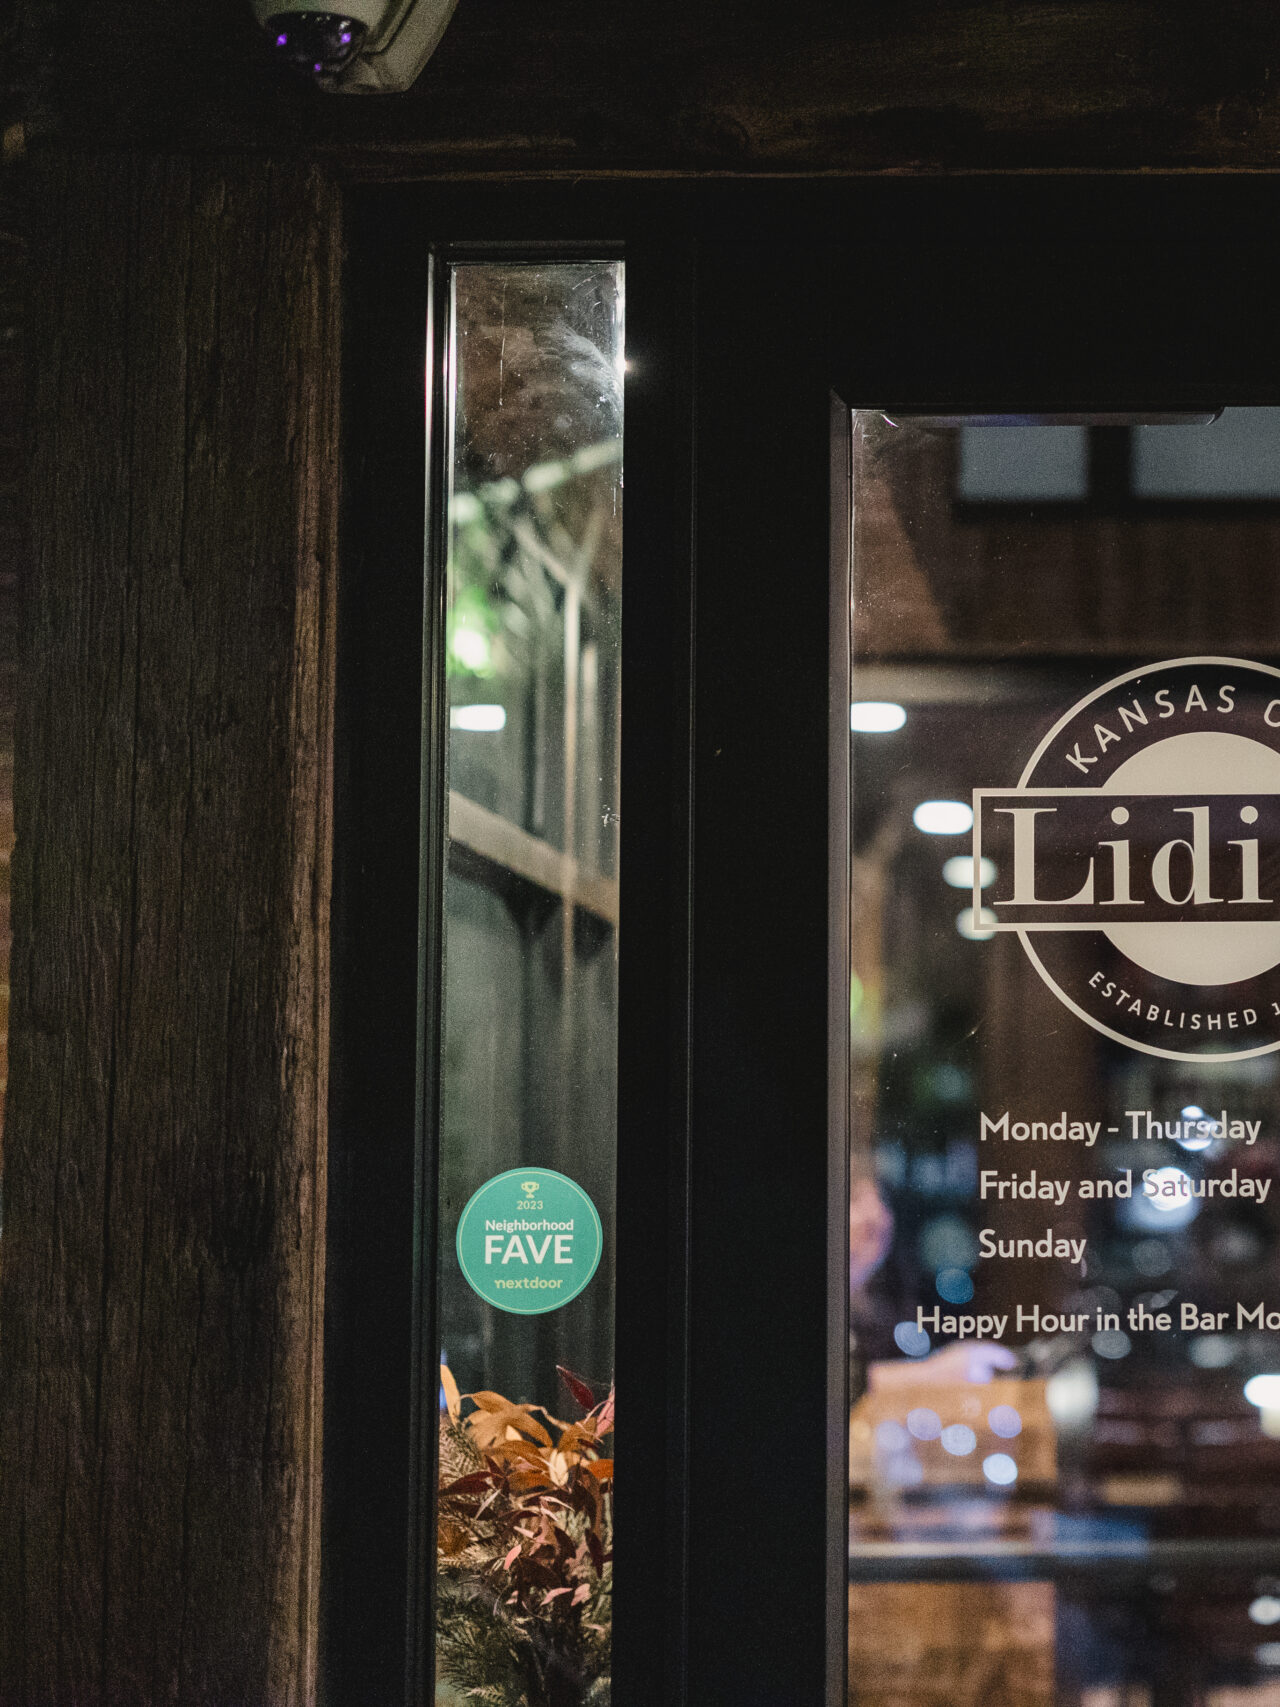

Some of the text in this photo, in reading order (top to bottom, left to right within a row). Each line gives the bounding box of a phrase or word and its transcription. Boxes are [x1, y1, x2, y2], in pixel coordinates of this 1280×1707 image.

[1065, 684, 1236, 774] KANSAS
[1089, 972, 1258, 1031] ESTABLISHED
[979, 1112, 1101, 1146] Monday
[1125, 1110, 1262, 1145] Thursday
[979, 1170, 1070, 1205] Friday
[1078, 1170, 1132, 1199] and
[1142, 1169, 1272, 1203] Saturday
[516, 1200, 544, 1210] 2023
[485, 1219, 574, 1233] Neighborhood
[484, 1234, 574, 1265] FAVE
[978, 1229, 1087, 1264] Sunday
[494, 1276, 563, 1289] nextdoor
[916, 1306, 1008, 1339] Happy
[1016, 1305, 1092, 1332] Hour
[1097, 1305, 1122, 1331] in
[1127, 1304, 1172, 1331] the
[1180, 1303, 1229, 1331] Bar
